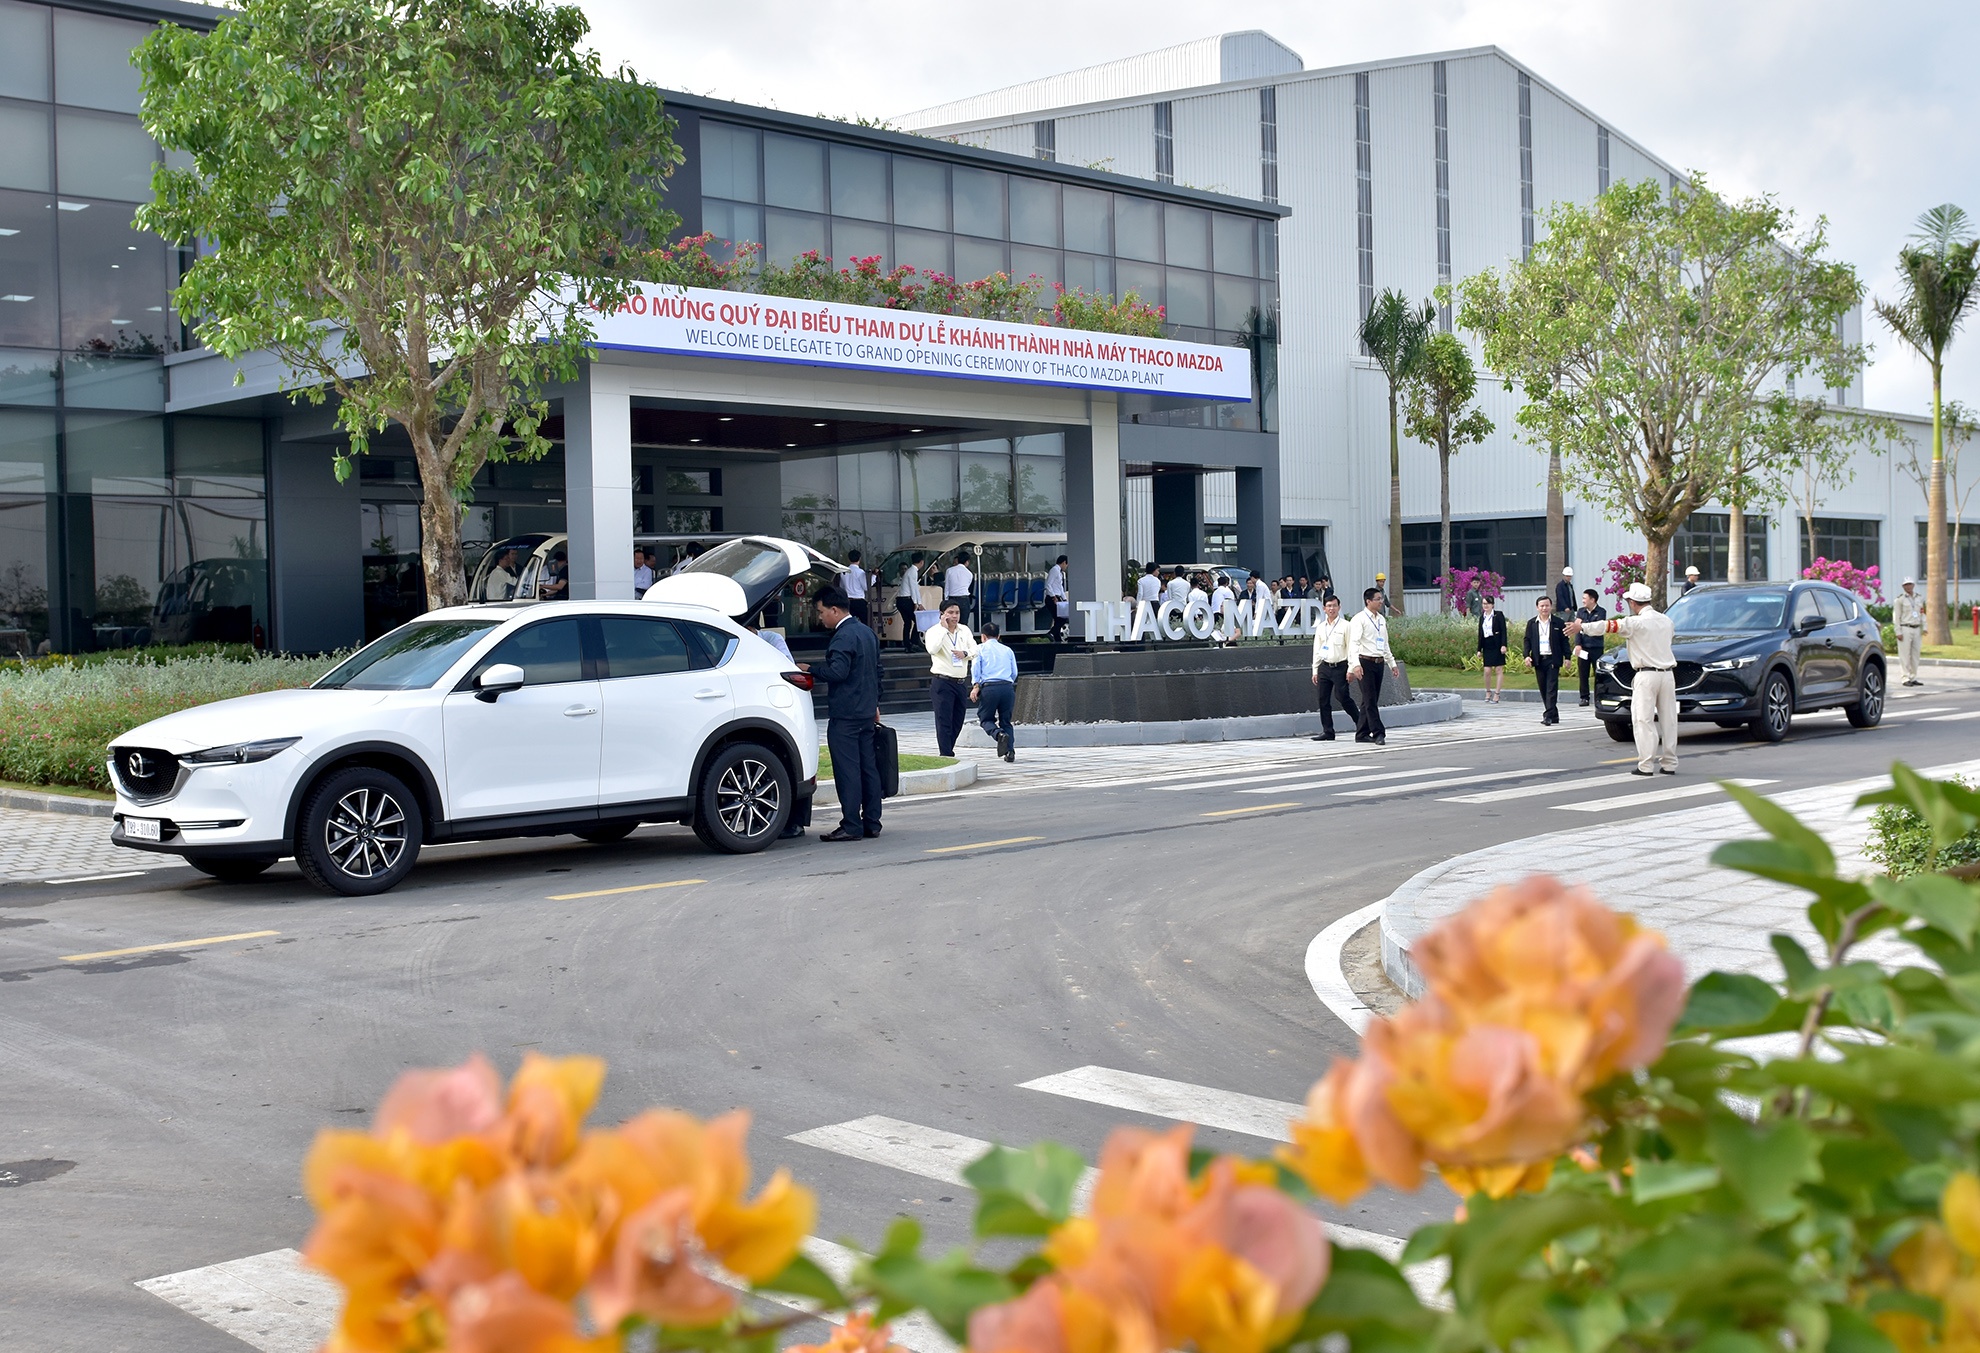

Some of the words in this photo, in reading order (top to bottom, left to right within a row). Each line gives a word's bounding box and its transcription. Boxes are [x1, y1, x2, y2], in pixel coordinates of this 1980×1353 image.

[653, 295, 715, 321] MỪNG
[719, 303, 760, 327] QUÝ
[764, 308, 796, 334] ĐẠI
[802, 307, 841, 333] BIỂU
[844, 316, 894, 339] THAM
[900, 322, 925, 347] DỰ
[929, 320, 946, 345] LỄ
[950, 327, 1005, 351] KHÁNH
[1008, 332, 1060, 356] THÀNH
[1063, 339, 1094, 359] NHÀ
[1097, 342, 1126, 363] MÁY
[1129, 347, 1174, 367] THACO
[1177, 352, 1223, 372] MAZDA
[686, 328, 759, 349] WELCOME
[763, 335, 832, 356] DELEGATE
[835, 342, 853, 357] TO
[856, 344, 903, 362] GRAND
[906, 349, 962, 367] OPENING
[965, 354, 1030, 373] CEREMONY
[1032, 360, 1047, 375] OF
[1050, 362, 1088, 379] THACO
[1090, 366, 1129, 383] MAZDA
[1132, 370, 1164, 385] PLANT
[1077, 599, 1215, 642] THACO
[1223, 598, 1345, 636] MAZD
